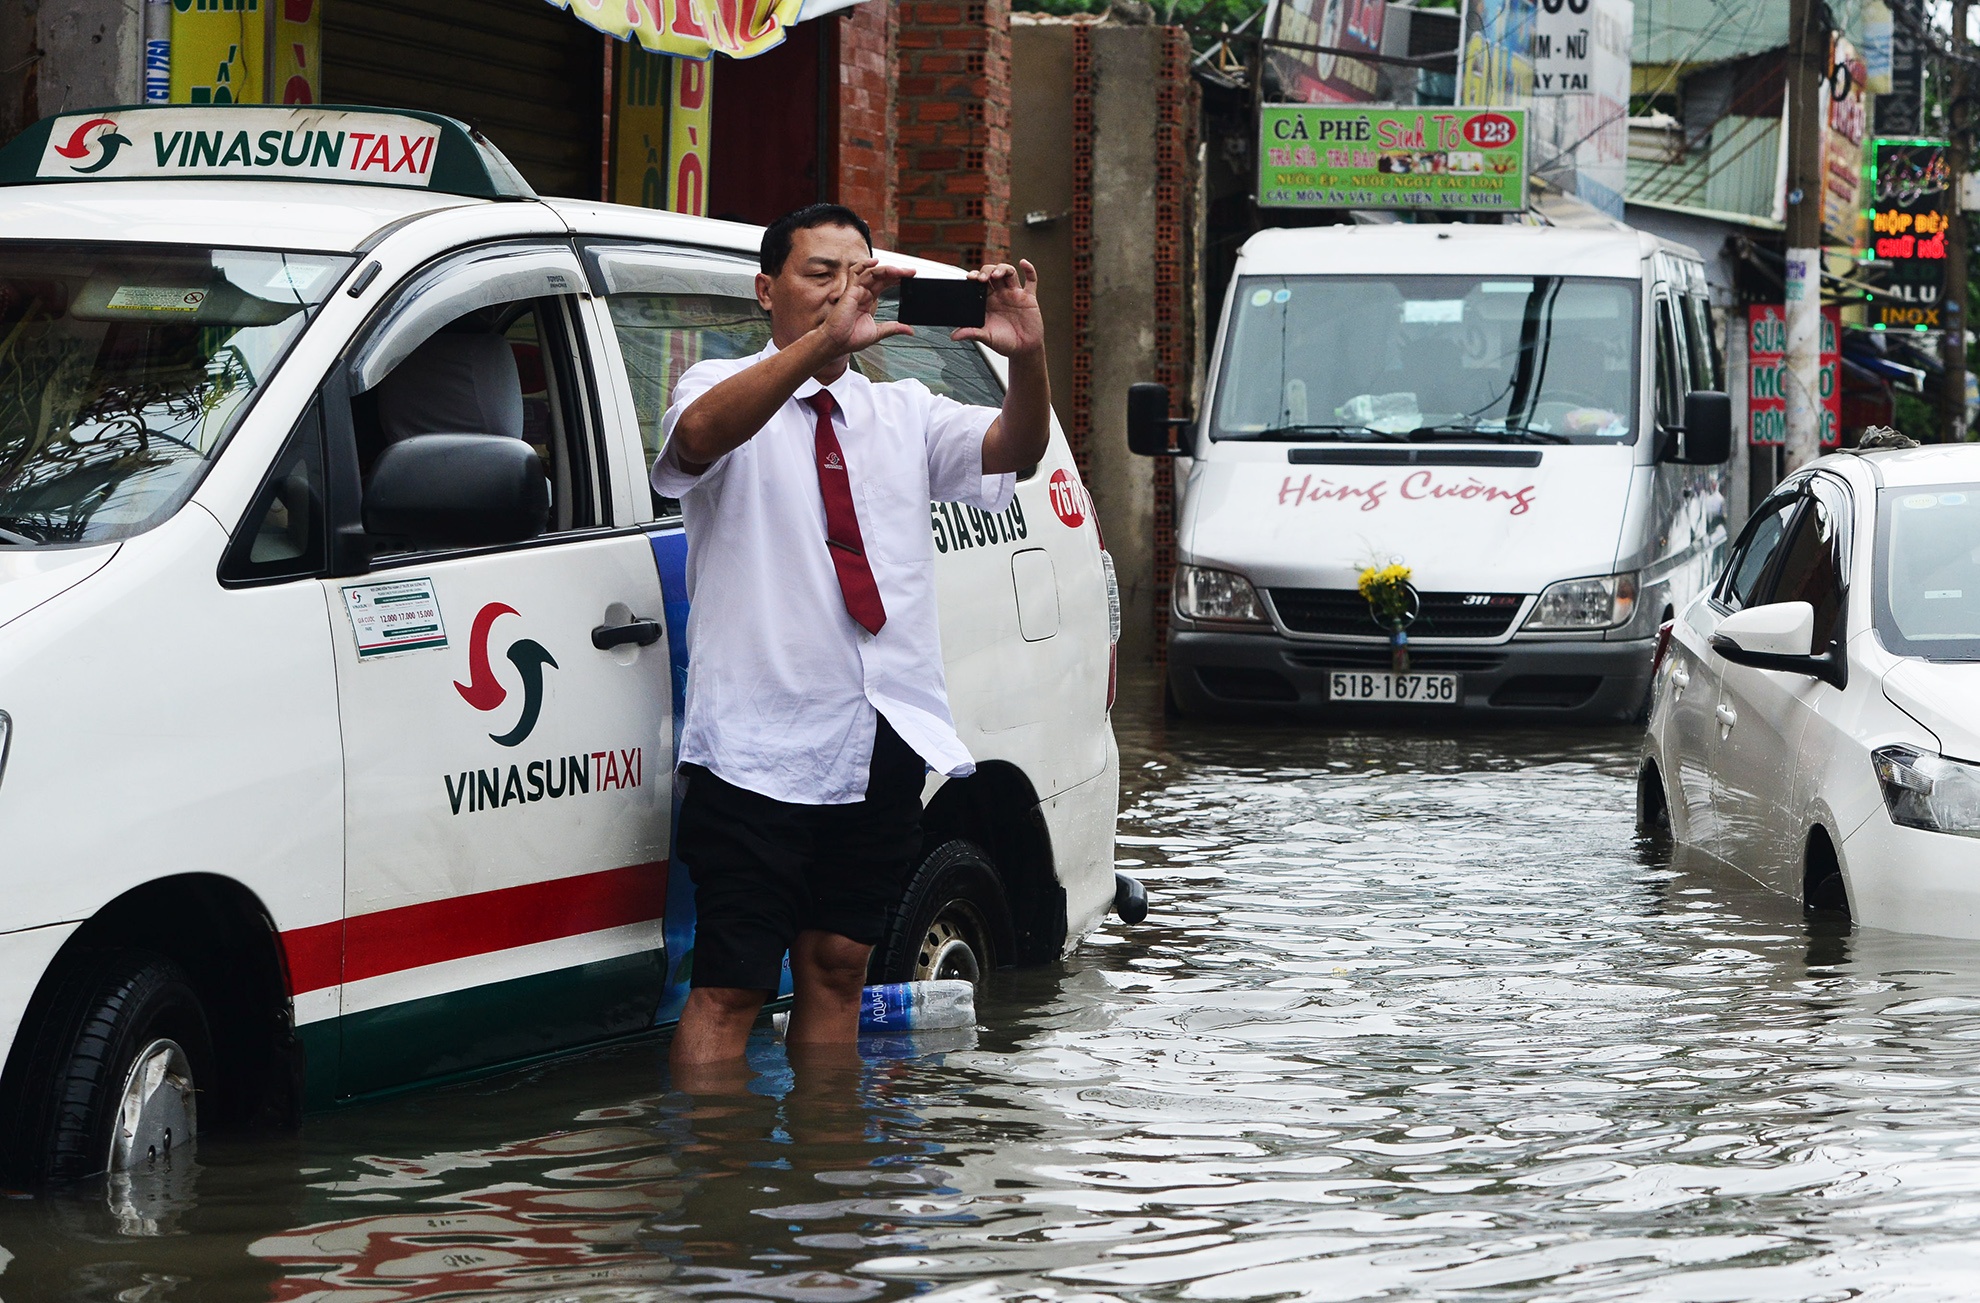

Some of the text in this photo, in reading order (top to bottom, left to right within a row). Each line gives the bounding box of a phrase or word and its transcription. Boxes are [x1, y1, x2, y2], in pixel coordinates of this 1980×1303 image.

[1559, 73, 1588, 89] TAI
[1274, 114, 1309, 140] CÀ
[1319, 115, 1371, 141] PHÊ
[1377, 115, 1427, 149] Sinh
[1471, 121, 1511, 142] 123
[1890, 284, 1937, 303] ALU
[1881, 307, 1939, 325] INOX
[1277, 471, 1536, 515] Hùng Cường
[379, 613, 398, 623] 12.000
[1333, 674, 1453, 700] 51B-167.56
